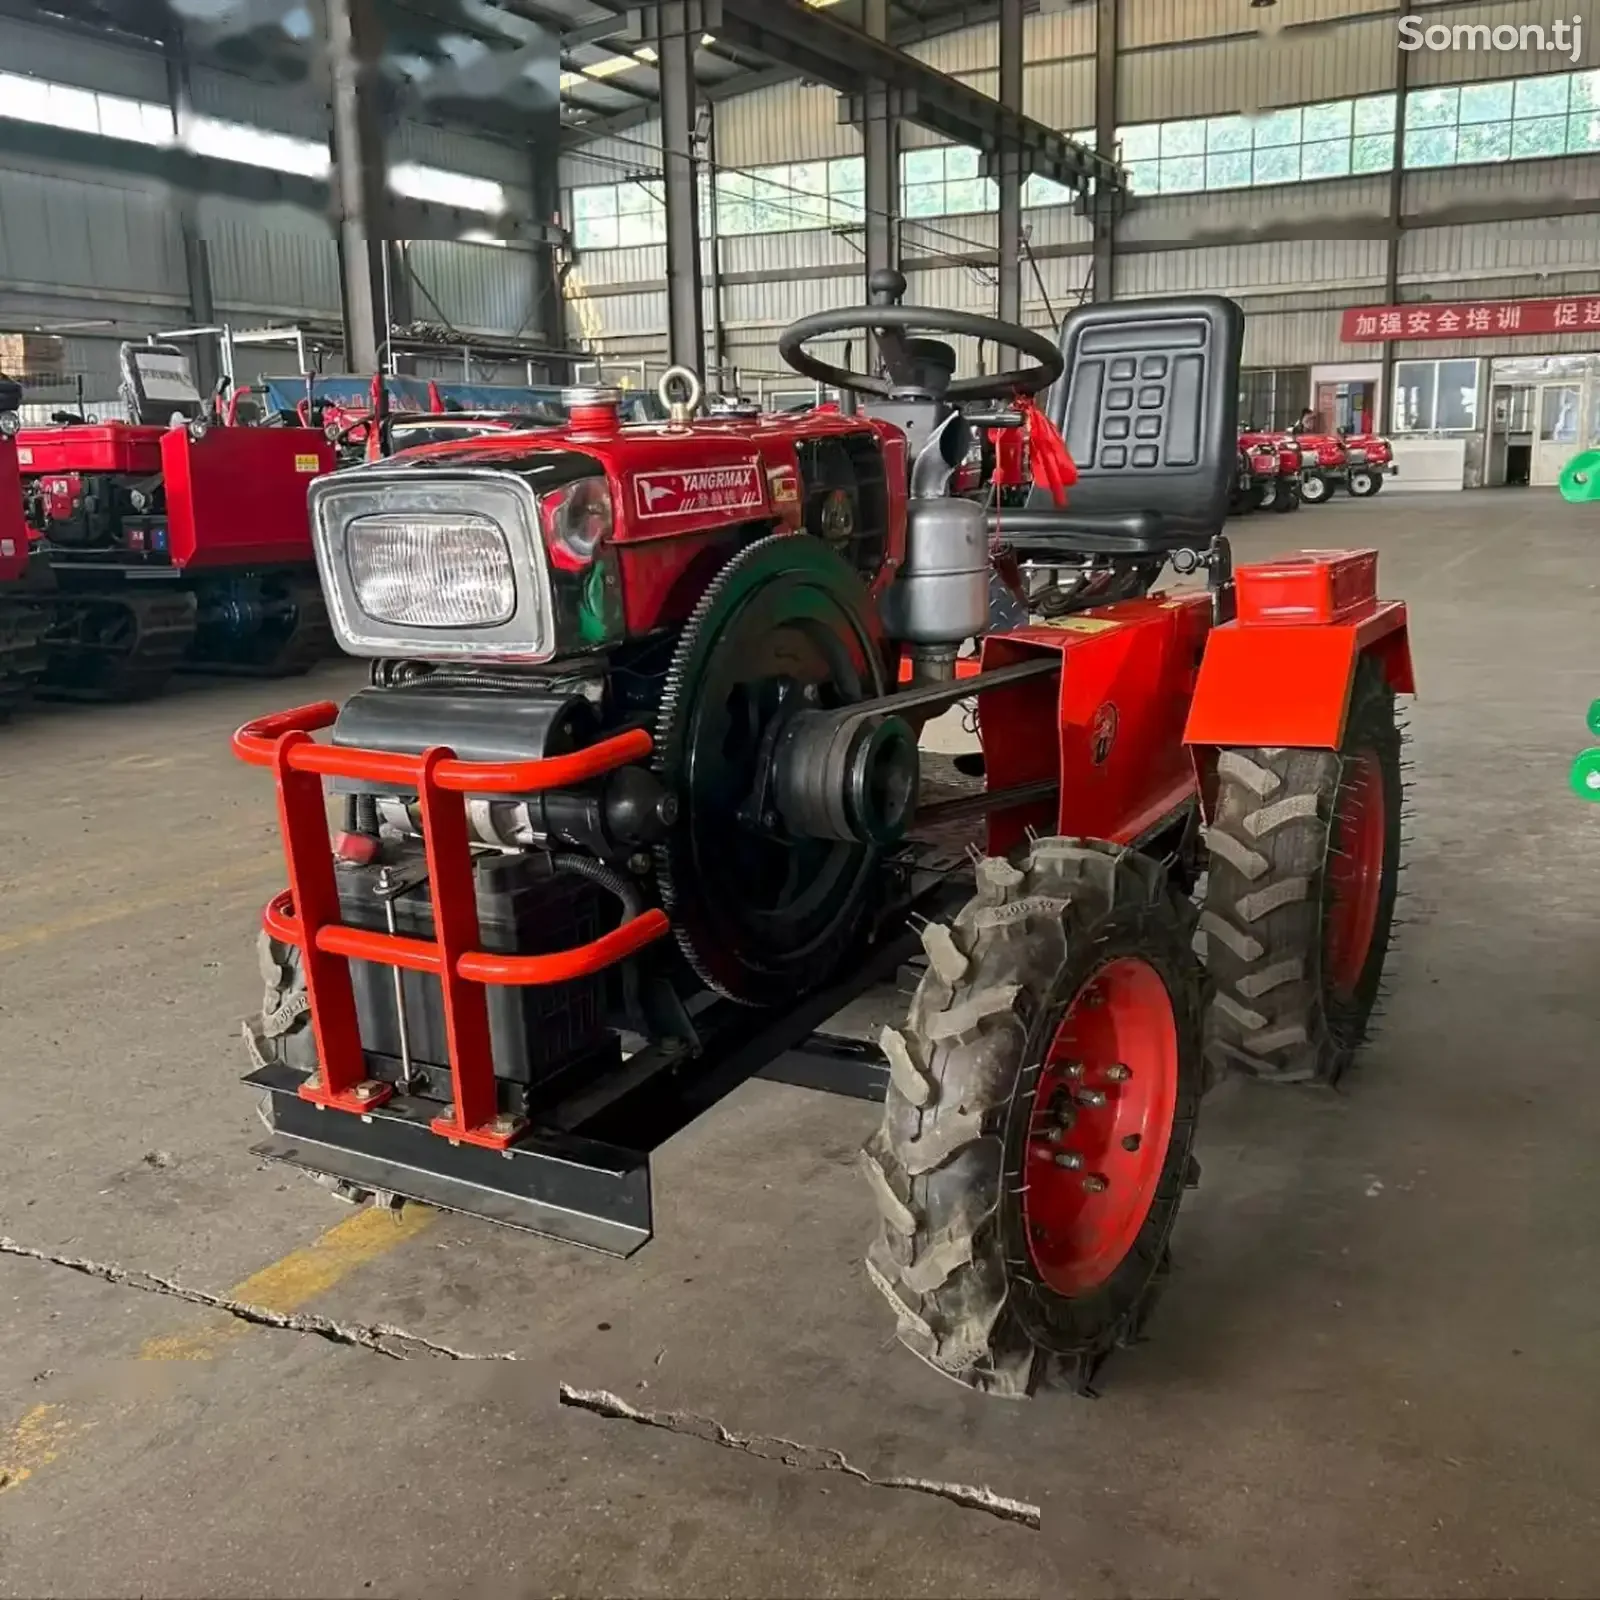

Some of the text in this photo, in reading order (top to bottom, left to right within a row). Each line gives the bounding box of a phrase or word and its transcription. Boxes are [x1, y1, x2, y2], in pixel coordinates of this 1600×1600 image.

[1355, 305, 1522, 336] 加强安全培训
[682, 470, 752, 491] YANGRMAX
